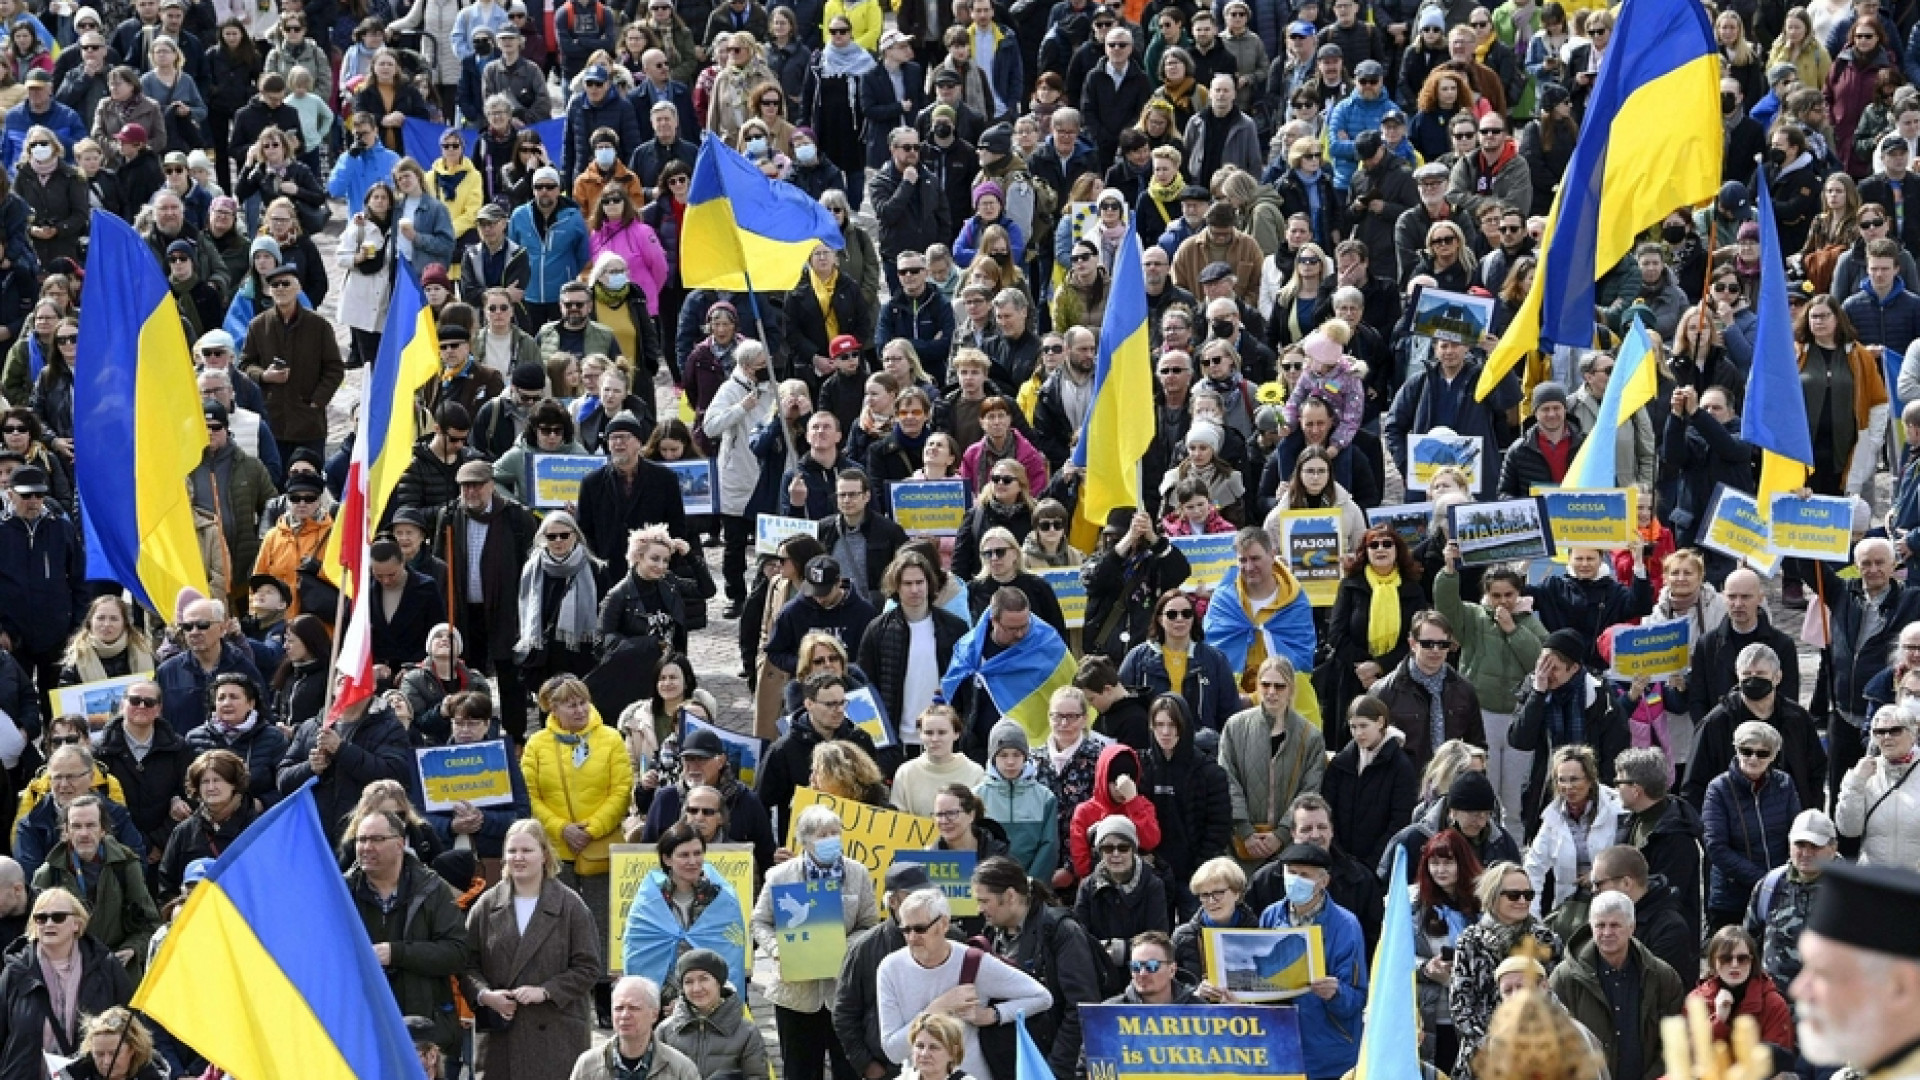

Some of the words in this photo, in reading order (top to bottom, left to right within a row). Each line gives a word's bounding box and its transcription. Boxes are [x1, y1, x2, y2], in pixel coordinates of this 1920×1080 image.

[1567, 502, 1606, 512] ODESSA
[1560, 522, 1569, 534] IS
[1571, 523, 1614, 535] UKRAINE
[1293, 538, 1337, 549] РАЗОМ
[1798, 530, 1837, 544] UKRAINE
[1631, 660, 1640, 669] IS
[1641, 653, 1680, 667] UKRAINE
[444, 756, 484, 768] CRIMEA
[440, 783, 449, 793] IS
[451, 779, 495, 792] UKRAINE
[816, 793, 935, 847] PUTIN
[929, 862, 960, 880] REE
[1116, 1016, 1266, 1037] MARIUPOL
[1121, 1044, 1144, 1065] is
[1147, 1046, 1269, 1066] UKRAINE
